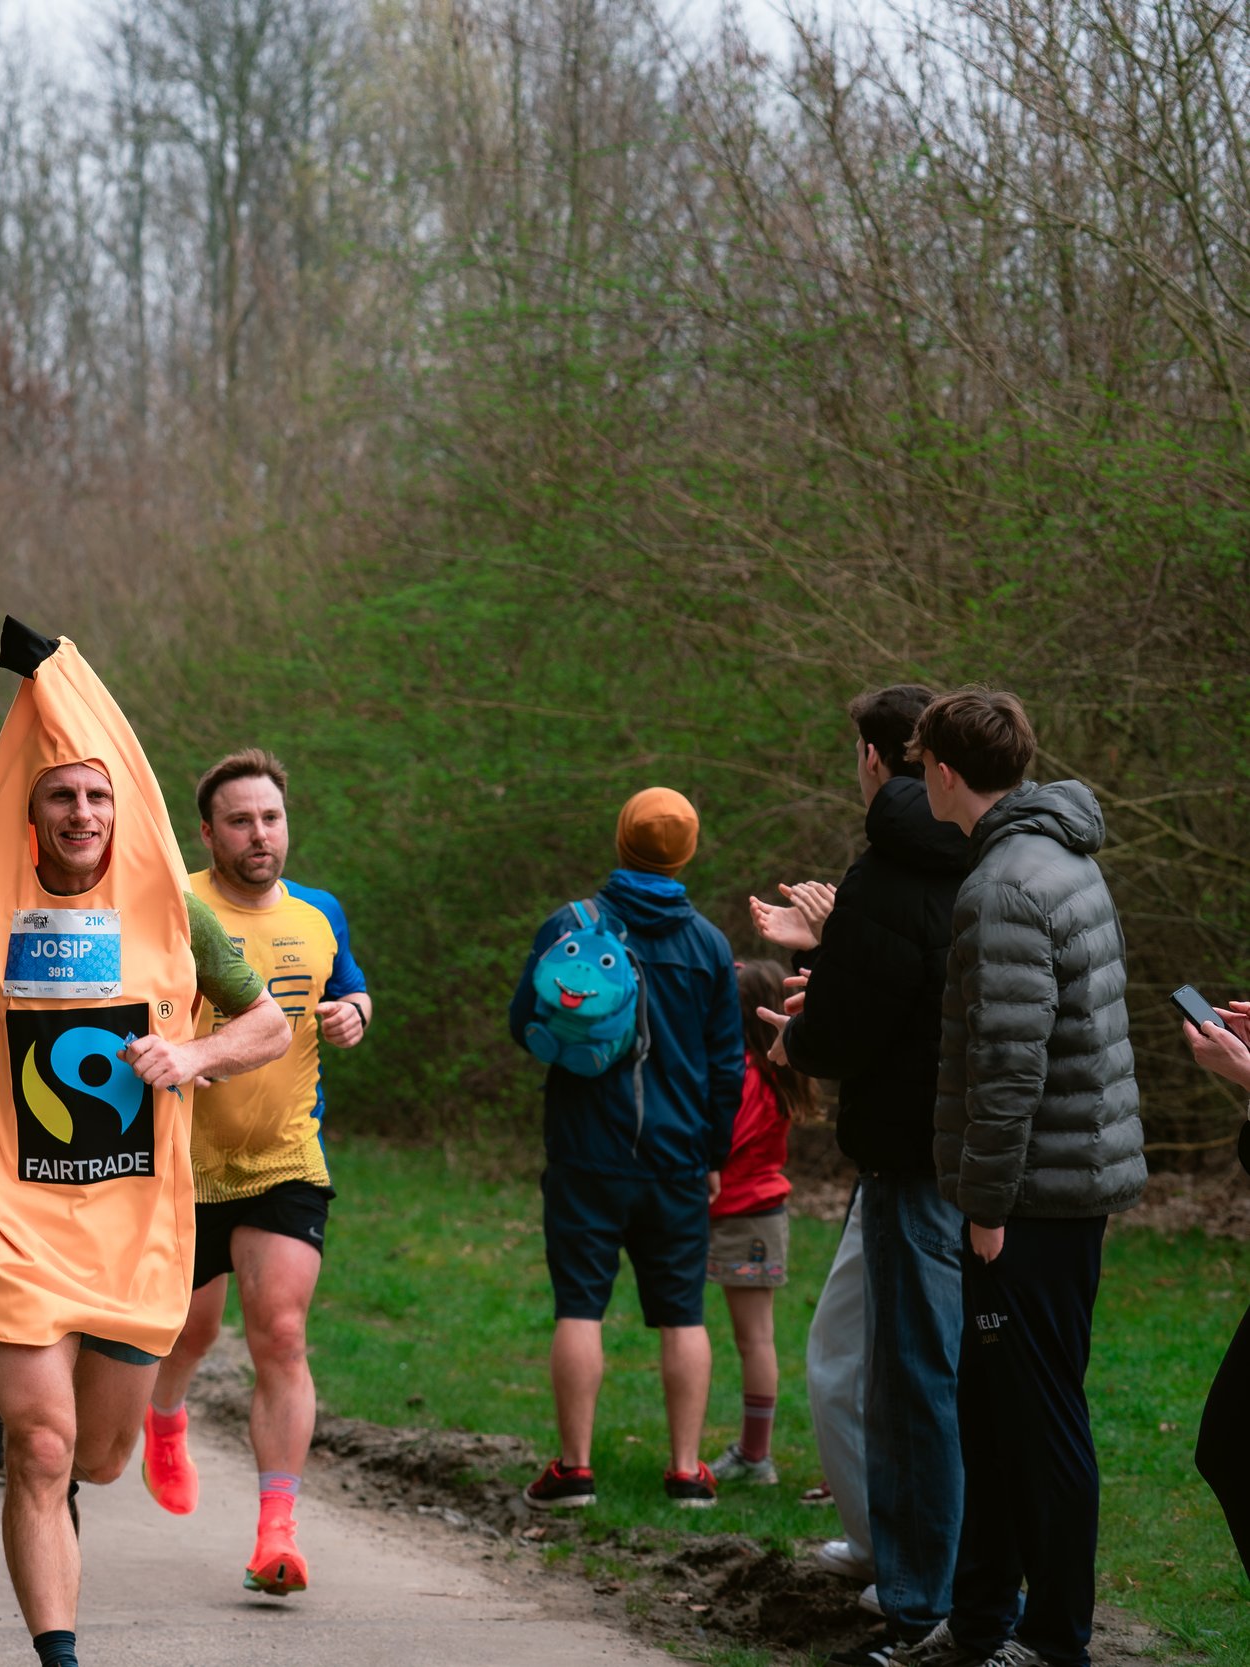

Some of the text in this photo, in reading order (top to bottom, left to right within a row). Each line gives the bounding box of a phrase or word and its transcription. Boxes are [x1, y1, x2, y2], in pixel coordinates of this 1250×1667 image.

[84, 916, 105, 926] 21K
[30, 940, 93, 958] JOSIP
[48, 966, 74, 978] 3913
[25, 1151, 150, 1181] FAIRTRADE
